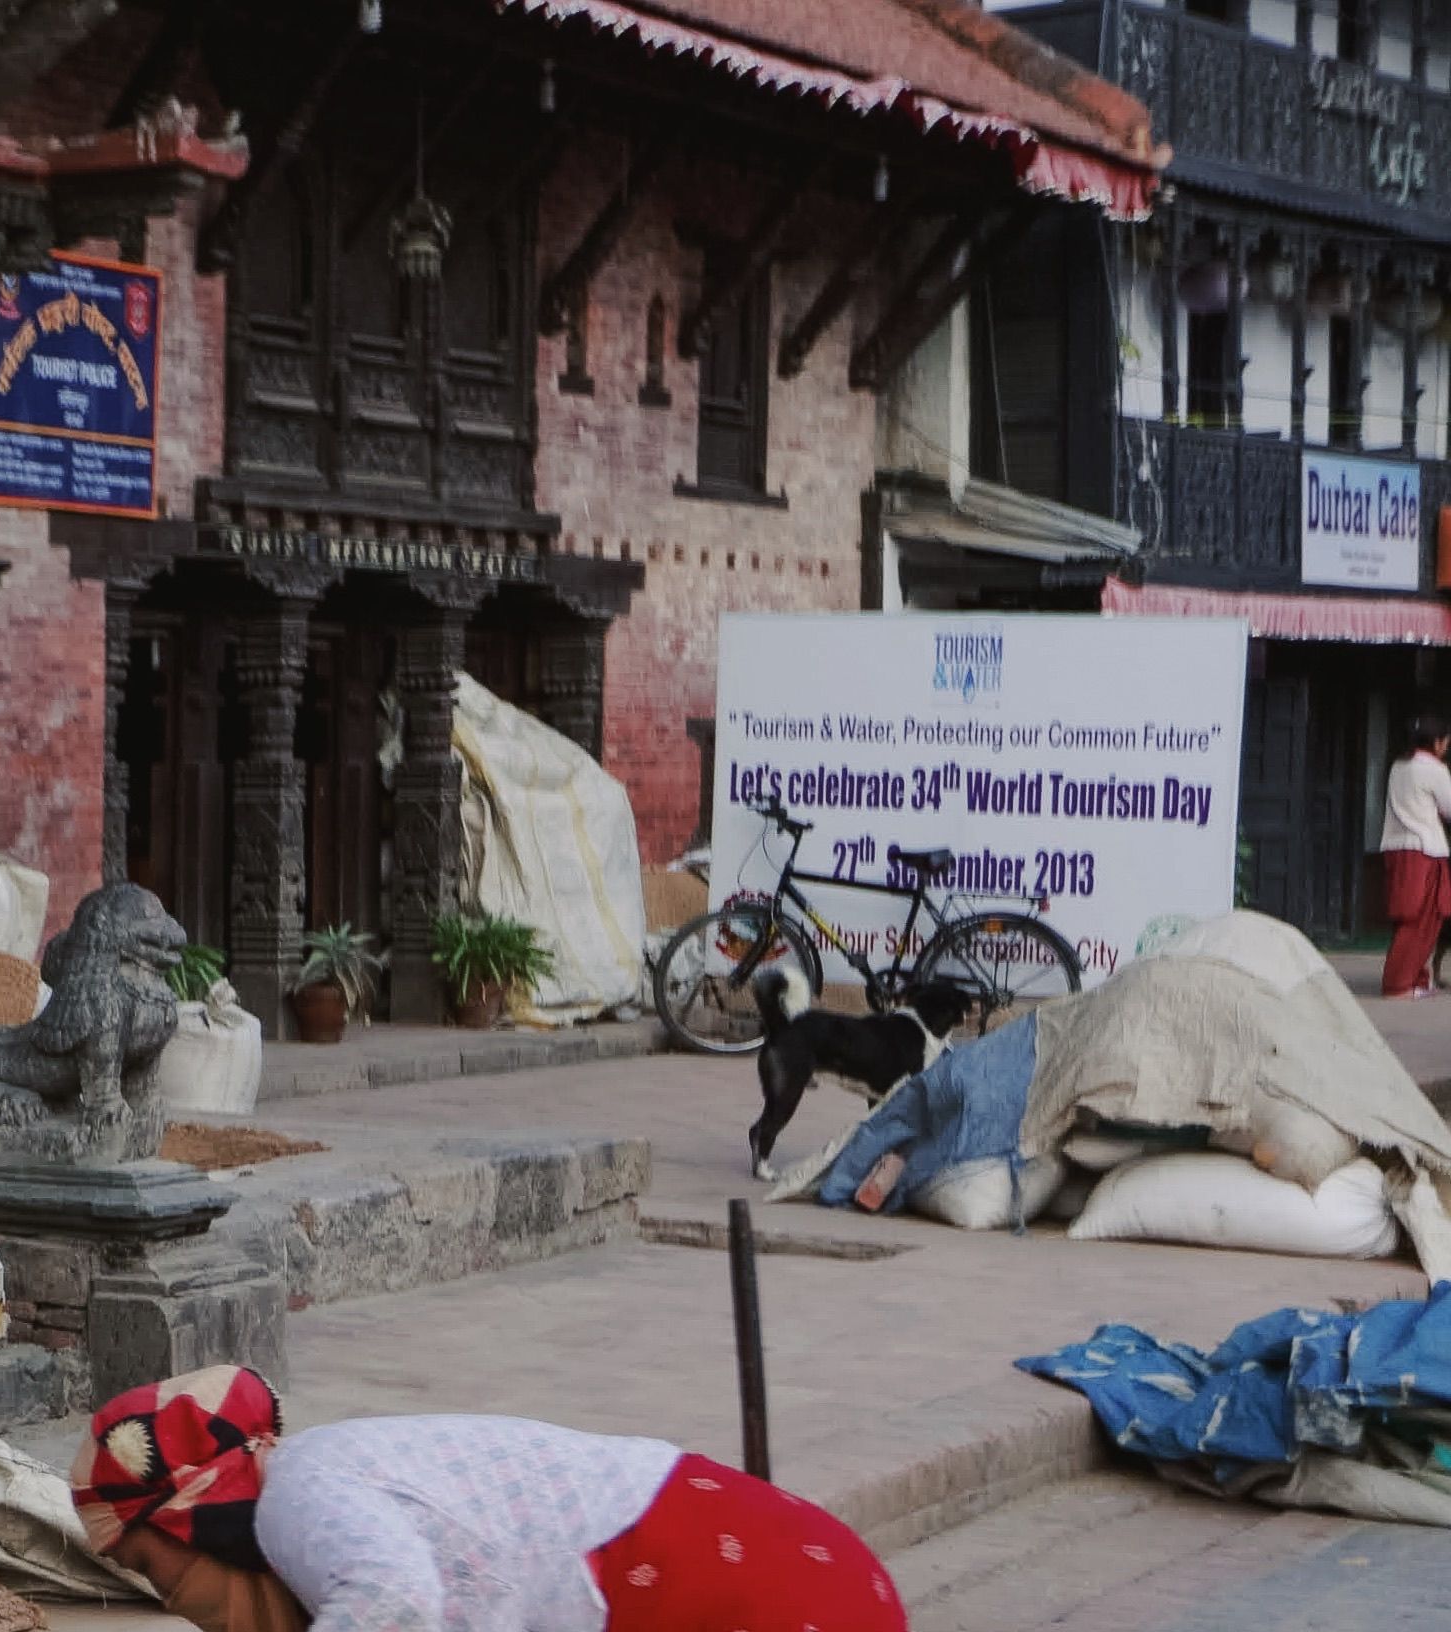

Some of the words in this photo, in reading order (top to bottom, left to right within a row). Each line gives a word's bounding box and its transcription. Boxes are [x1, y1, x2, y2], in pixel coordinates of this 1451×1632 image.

[1307, 468, 1371, 536] Durbar
[1378, 475, 1417, 540] Cafe
[935, 634, 1003, 664] TOURISM
[743, 713, 814, 741] Tourism
[820, 714, 833, 742] &
[839, 715, 896, 748] Water,
[903, 716, 1003, 754] Protecting
[1010, 730, 1042, 748] our
[1049, 721, 1136, 750] Common
[730, 760, 783, 803] Let's
[788, 763, 905, 809] celebrate
[911, 760, 961, 812] 34th
[966, 769, 1043, 814] World
[1049, 774, 1155, 821] Tourism
[1162, 775, 1212, 827] Day
[887, 845, 1027, 898] Seember,
[1034, 850, 1095, 896] 2013
[1076, 936, 1119, 973] City
